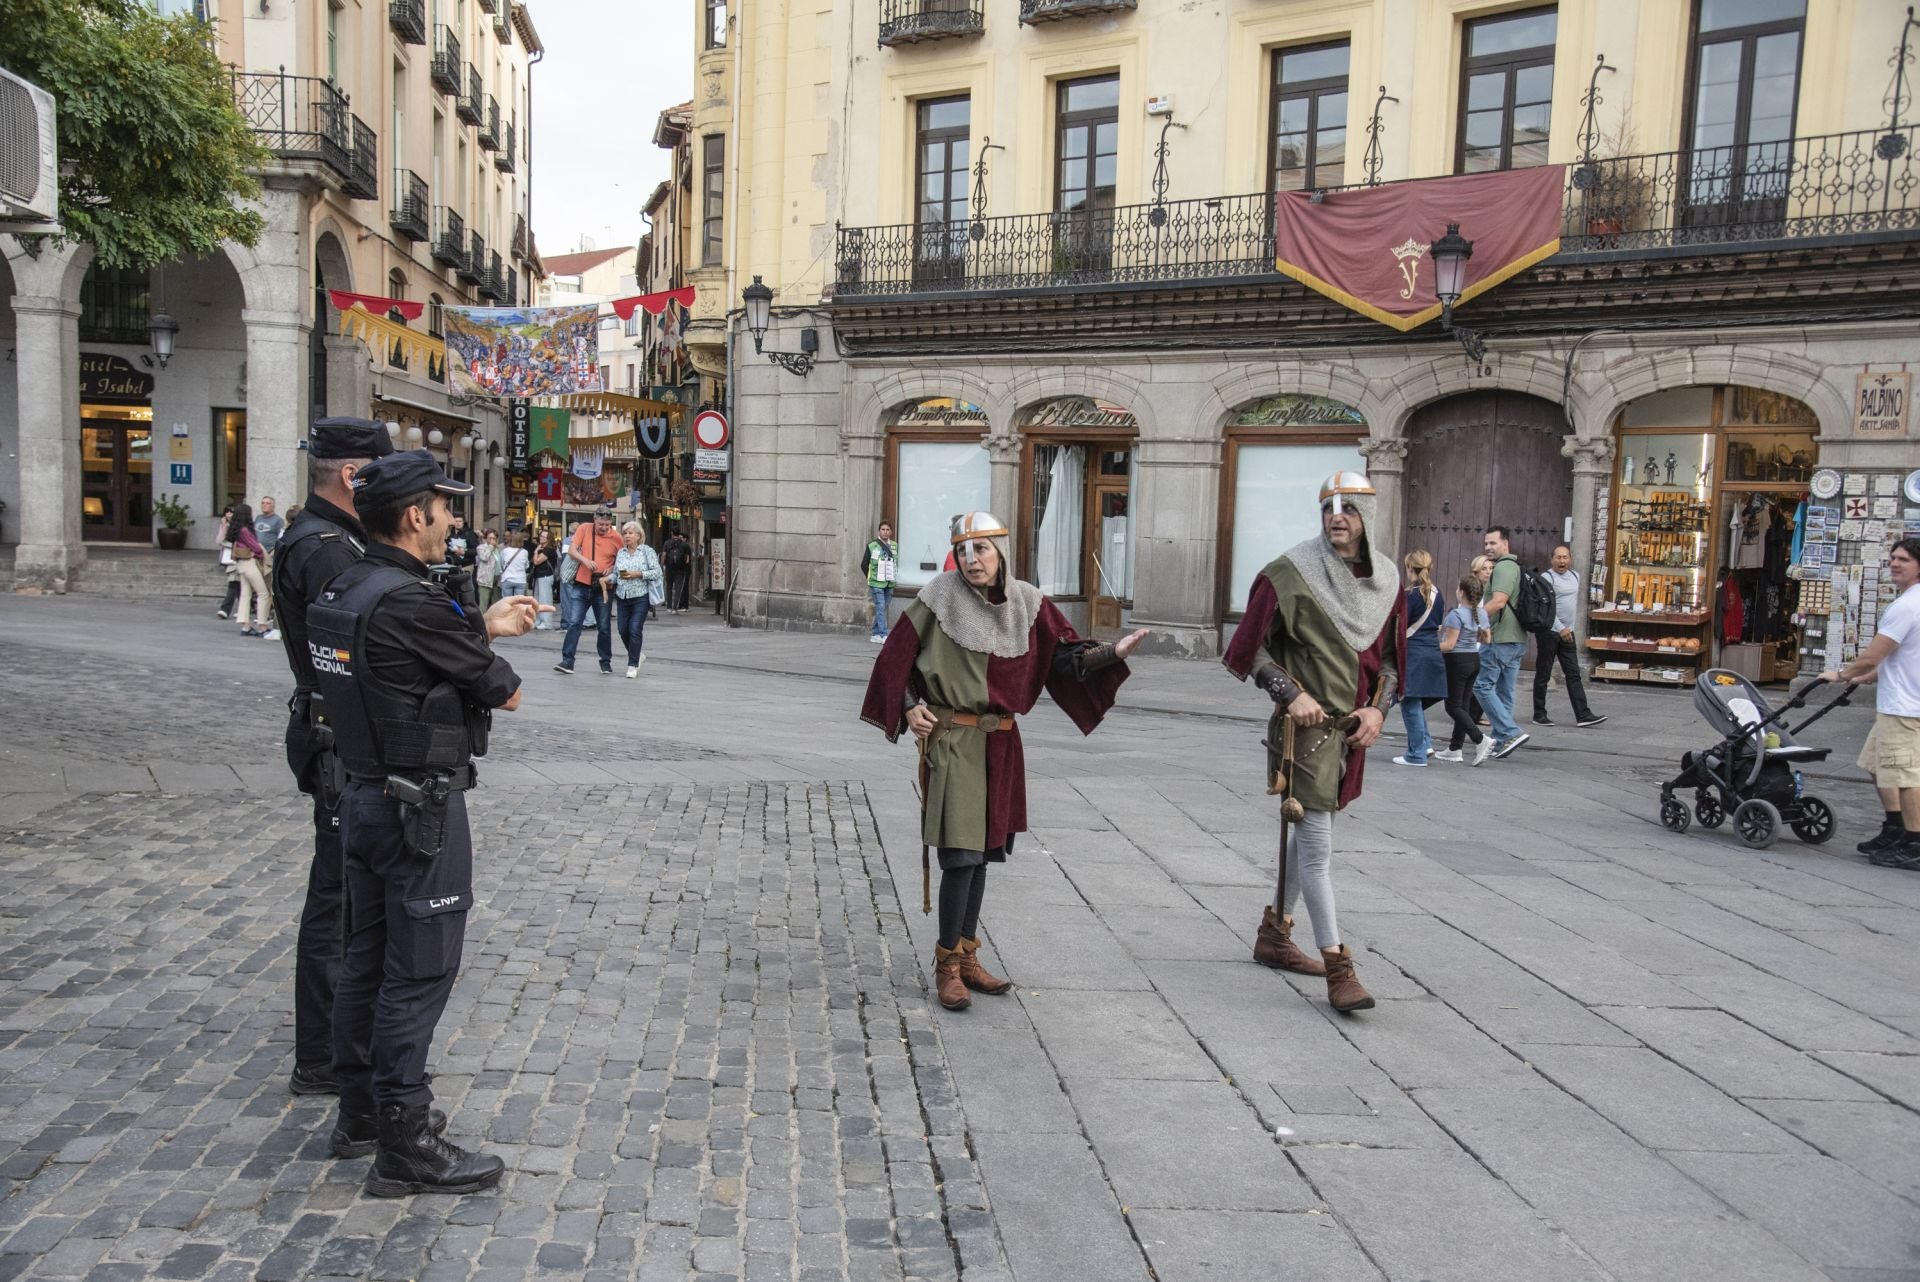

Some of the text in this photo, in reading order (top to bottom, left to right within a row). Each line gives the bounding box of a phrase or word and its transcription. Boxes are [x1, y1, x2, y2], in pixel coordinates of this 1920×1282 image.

[80, 356, 112, 372] otel
[1476, 366, 1493, 378] 10
[97, 378, 145, 394] Isabel
[1860, 388, 1903, 417] BALBINO
[308, 640, 338, 661] OLICIA
[312, 656, 353, 676] CIONAL
[429, 895, 460, 909] CNP
